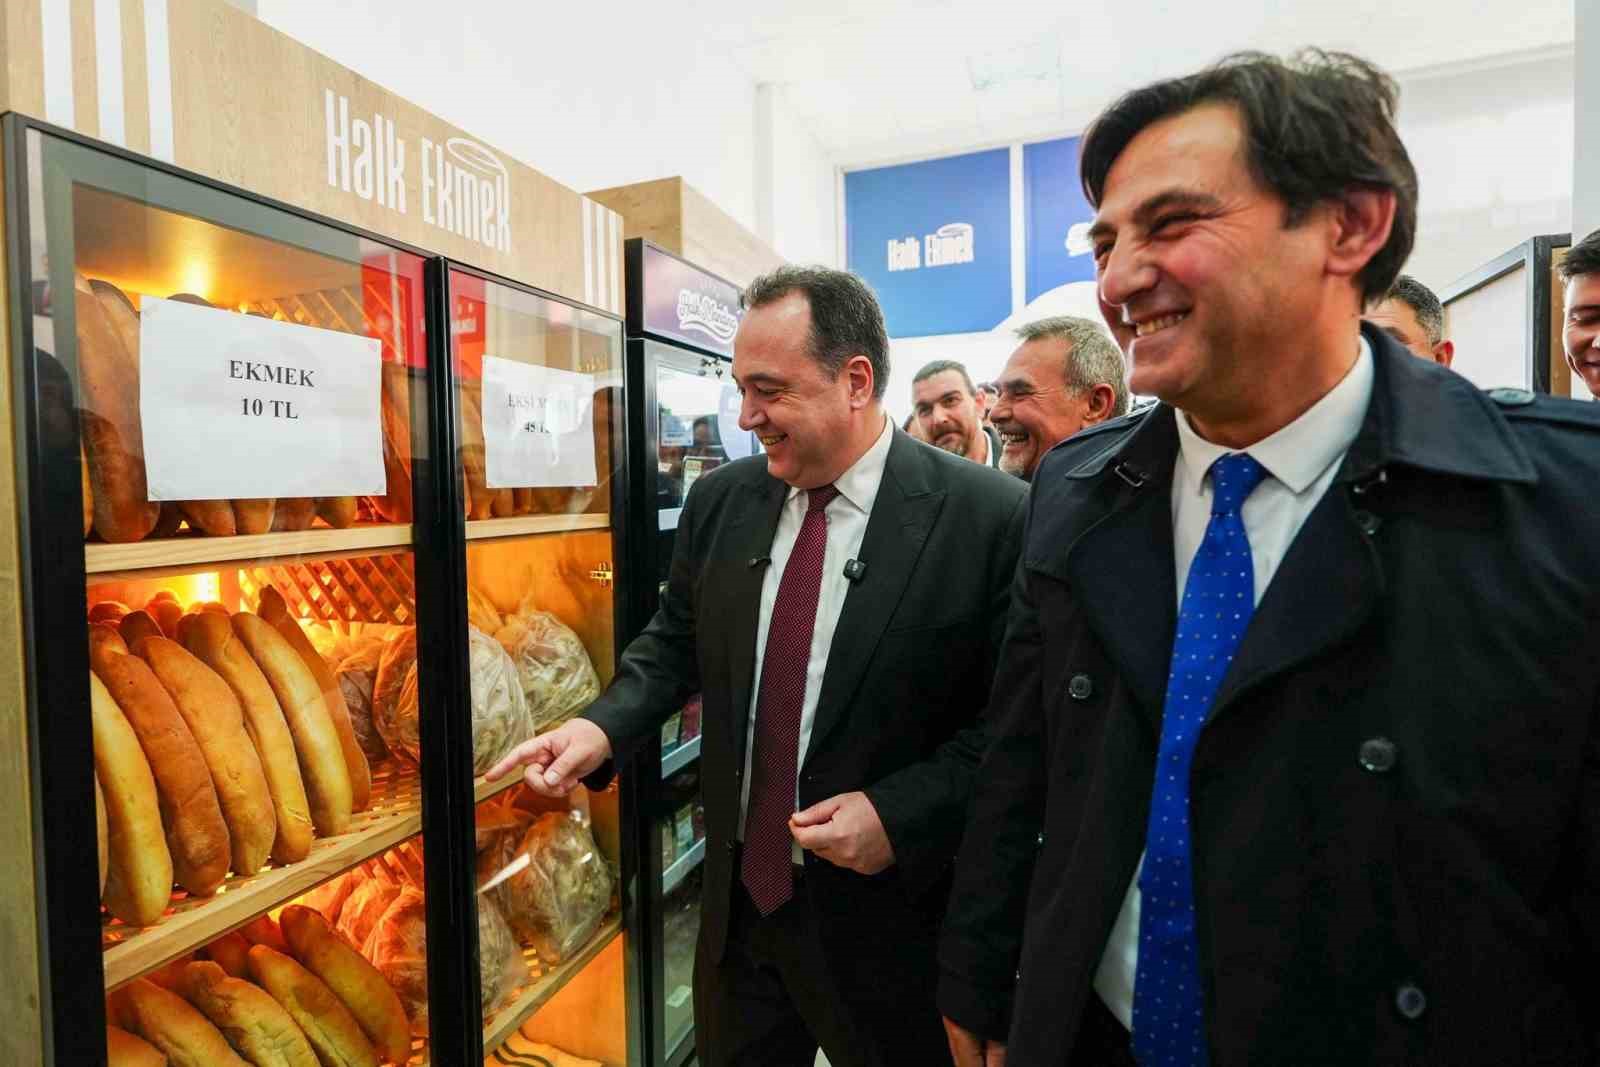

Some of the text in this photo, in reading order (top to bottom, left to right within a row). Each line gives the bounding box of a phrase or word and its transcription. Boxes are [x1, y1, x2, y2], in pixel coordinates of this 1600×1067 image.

[325, 88, 512, 256] Halk Ekmek
[229, 360, 315, 387] EKMEK
[242, 398, 298, 419] 10 TL
